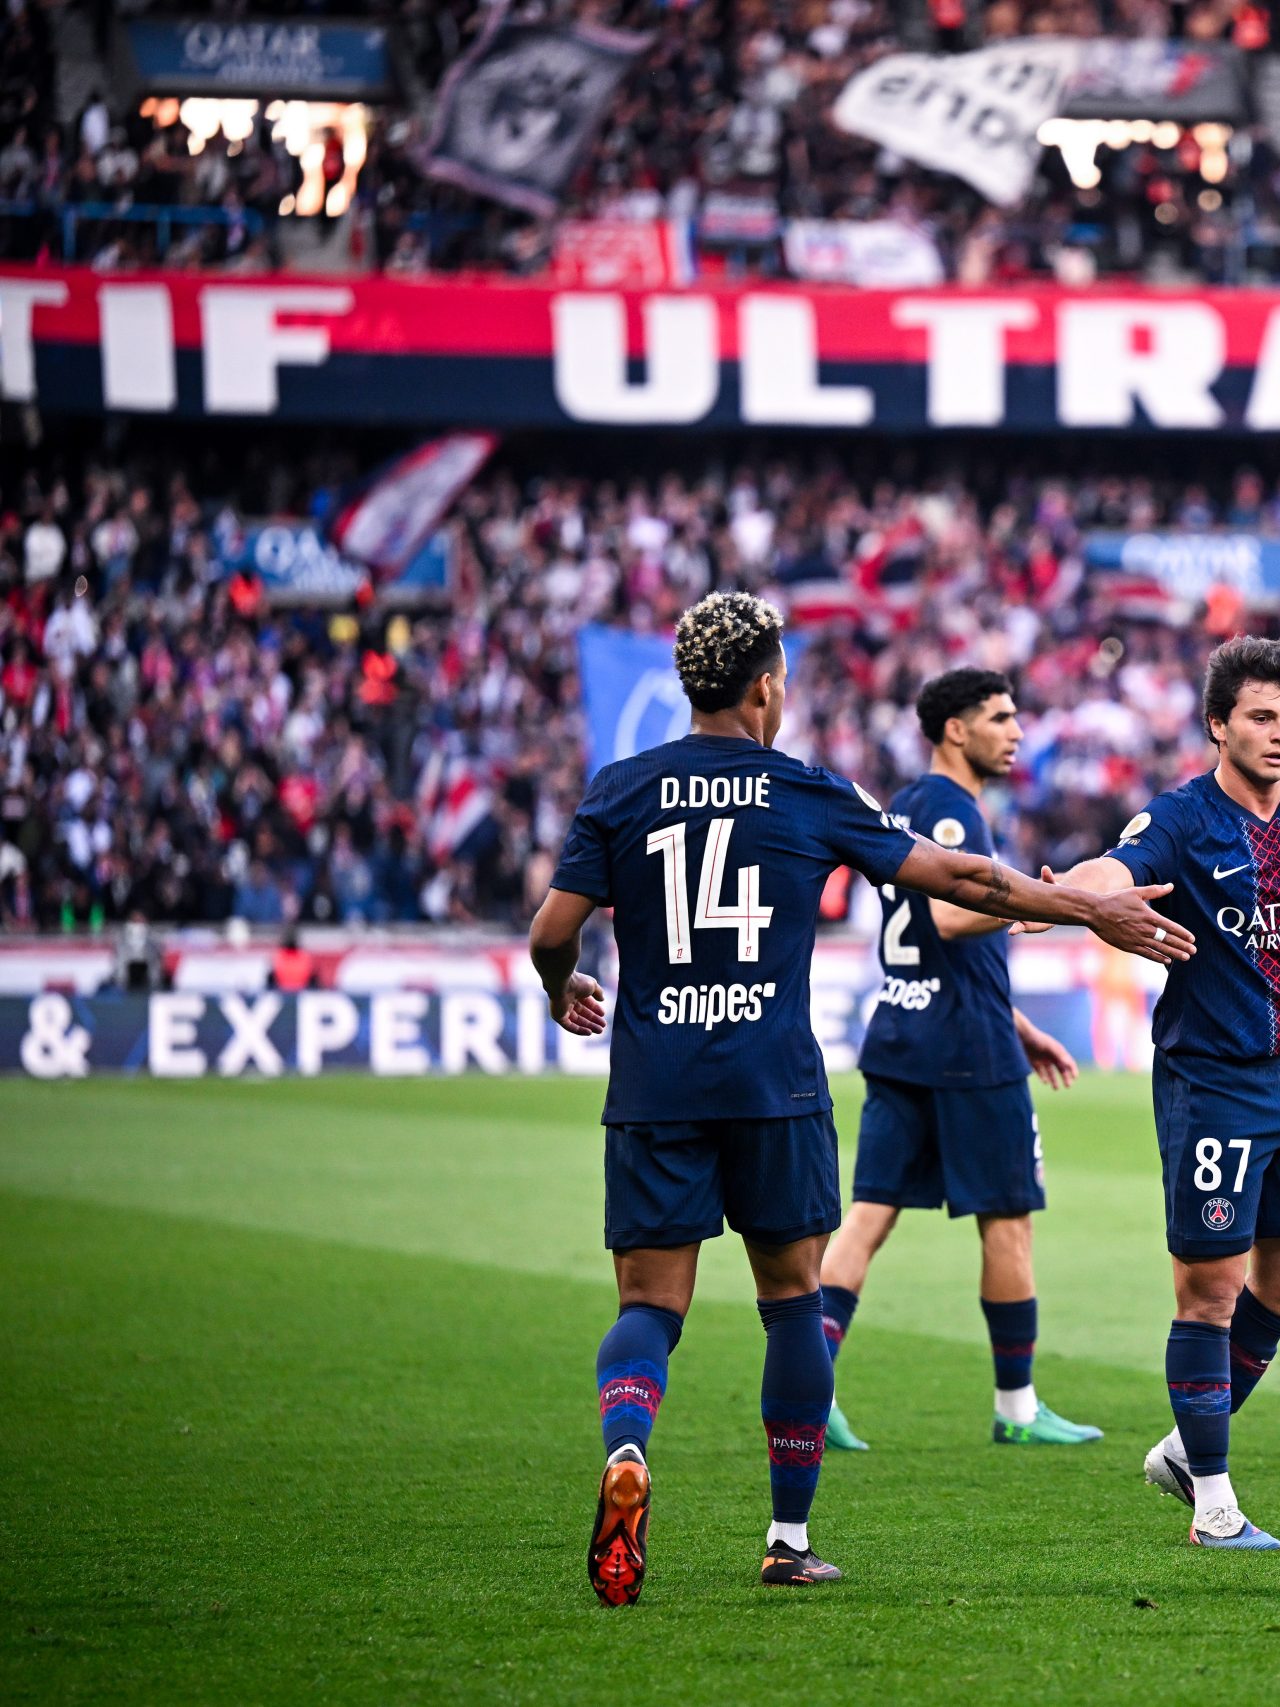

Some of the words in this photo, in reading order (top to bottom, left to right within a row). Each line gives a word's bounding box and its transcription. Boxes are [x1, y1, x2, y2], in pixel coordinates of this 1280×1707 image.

[660, 773, 770, 809] D.DOUÉ
[646, 818, 774, 965] 14
[657, 983, 776, 1031] snipes
[19, 992, 91, 1080] &
[1193, 1137, 1252, 1193] 87
[605, 1385, 649, 1400] PARIS
[773, 1437, 815, 1451] PARIS
